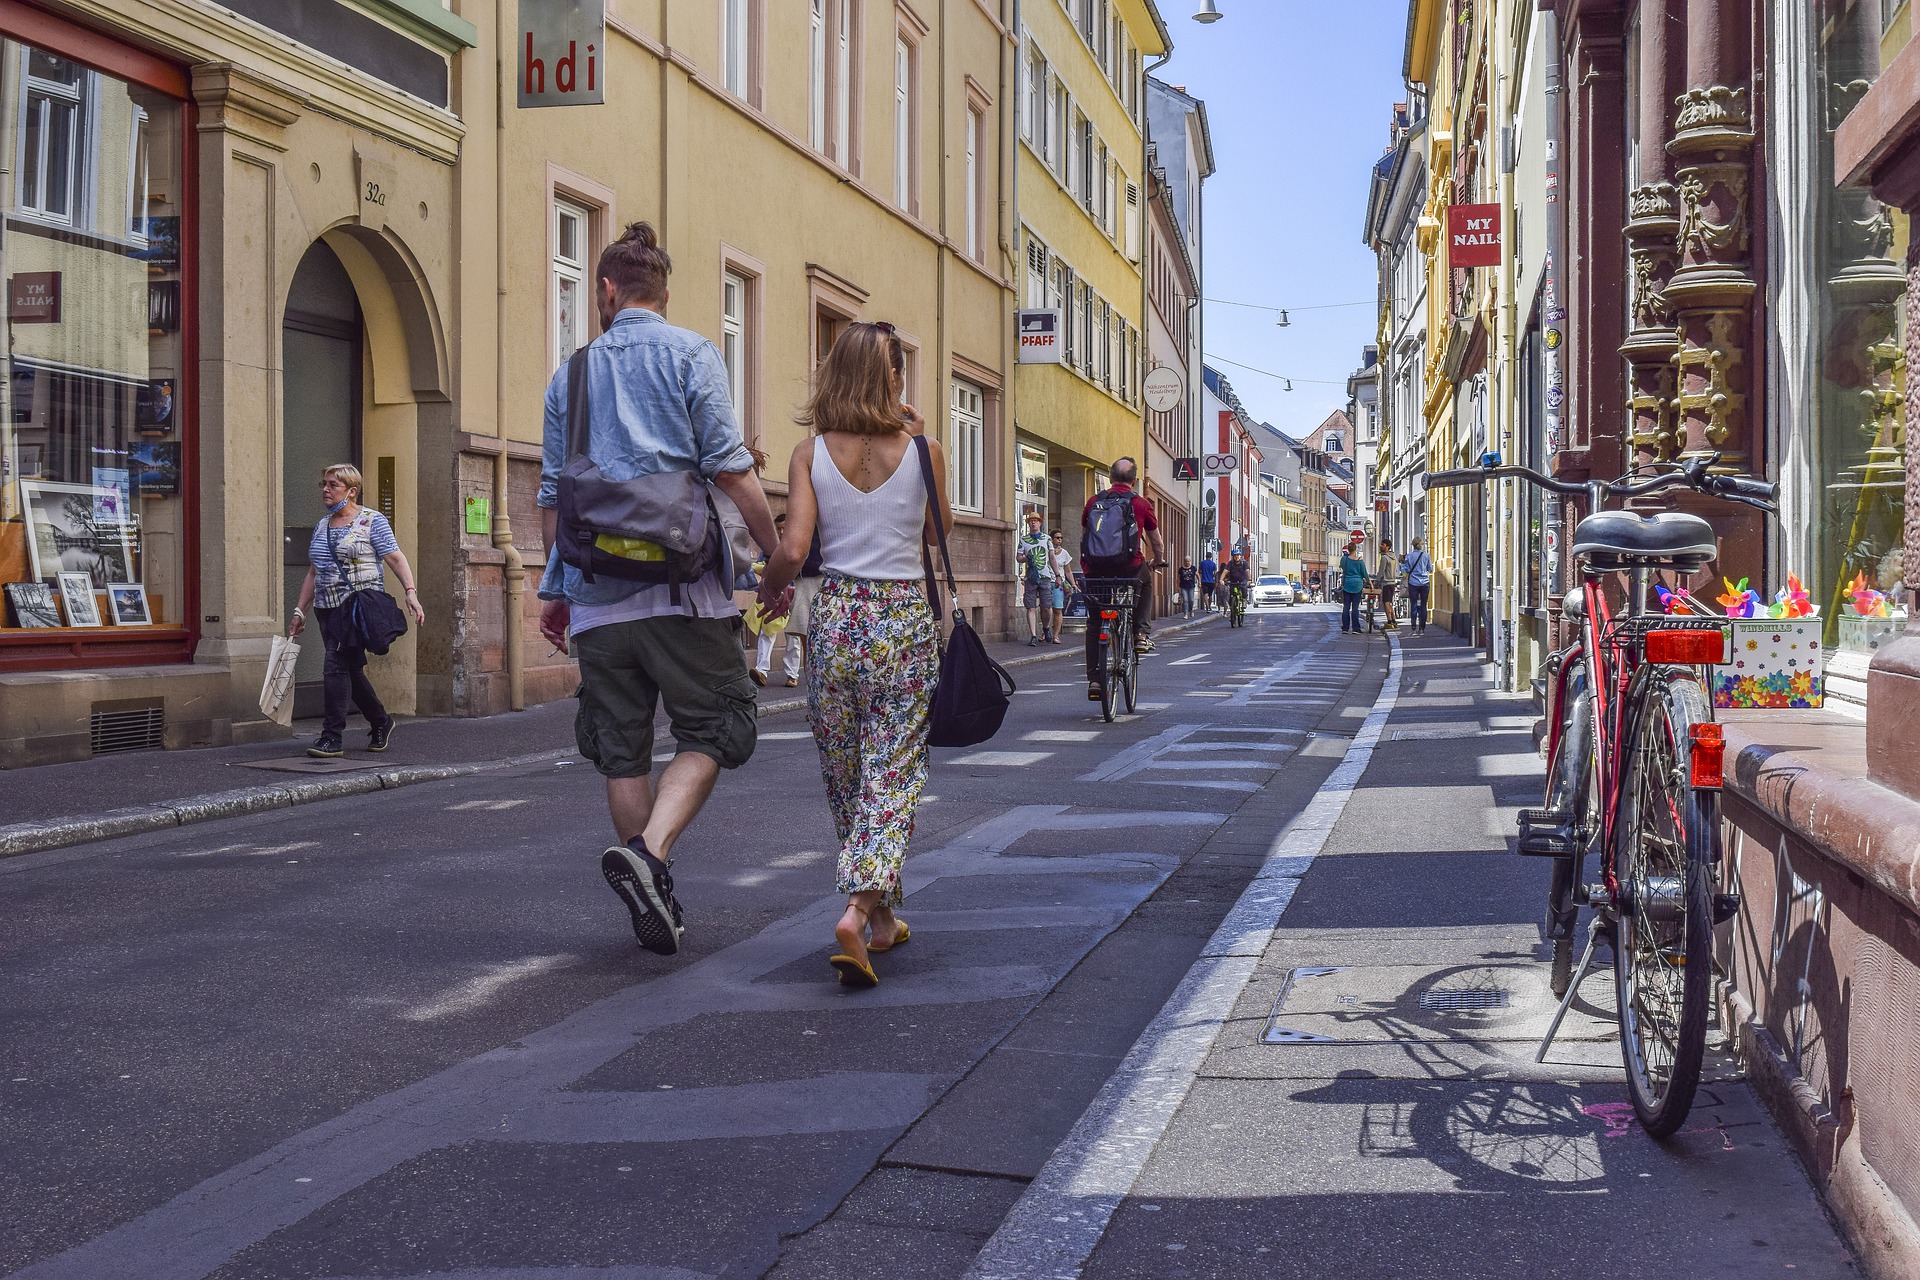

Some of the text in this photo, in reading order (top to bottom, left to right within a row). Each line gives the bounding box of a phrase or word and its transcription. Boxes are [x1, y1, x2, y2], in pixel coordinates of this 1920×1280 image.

[526, 32, 596, 94] hdi
[365, 181, 386, 206] 32a
[1466, 218, 1493, 231] MY
[1021, 335, 1055, 346] PFAFF
[1739, 624, 1793, 633] WINDMILLS
